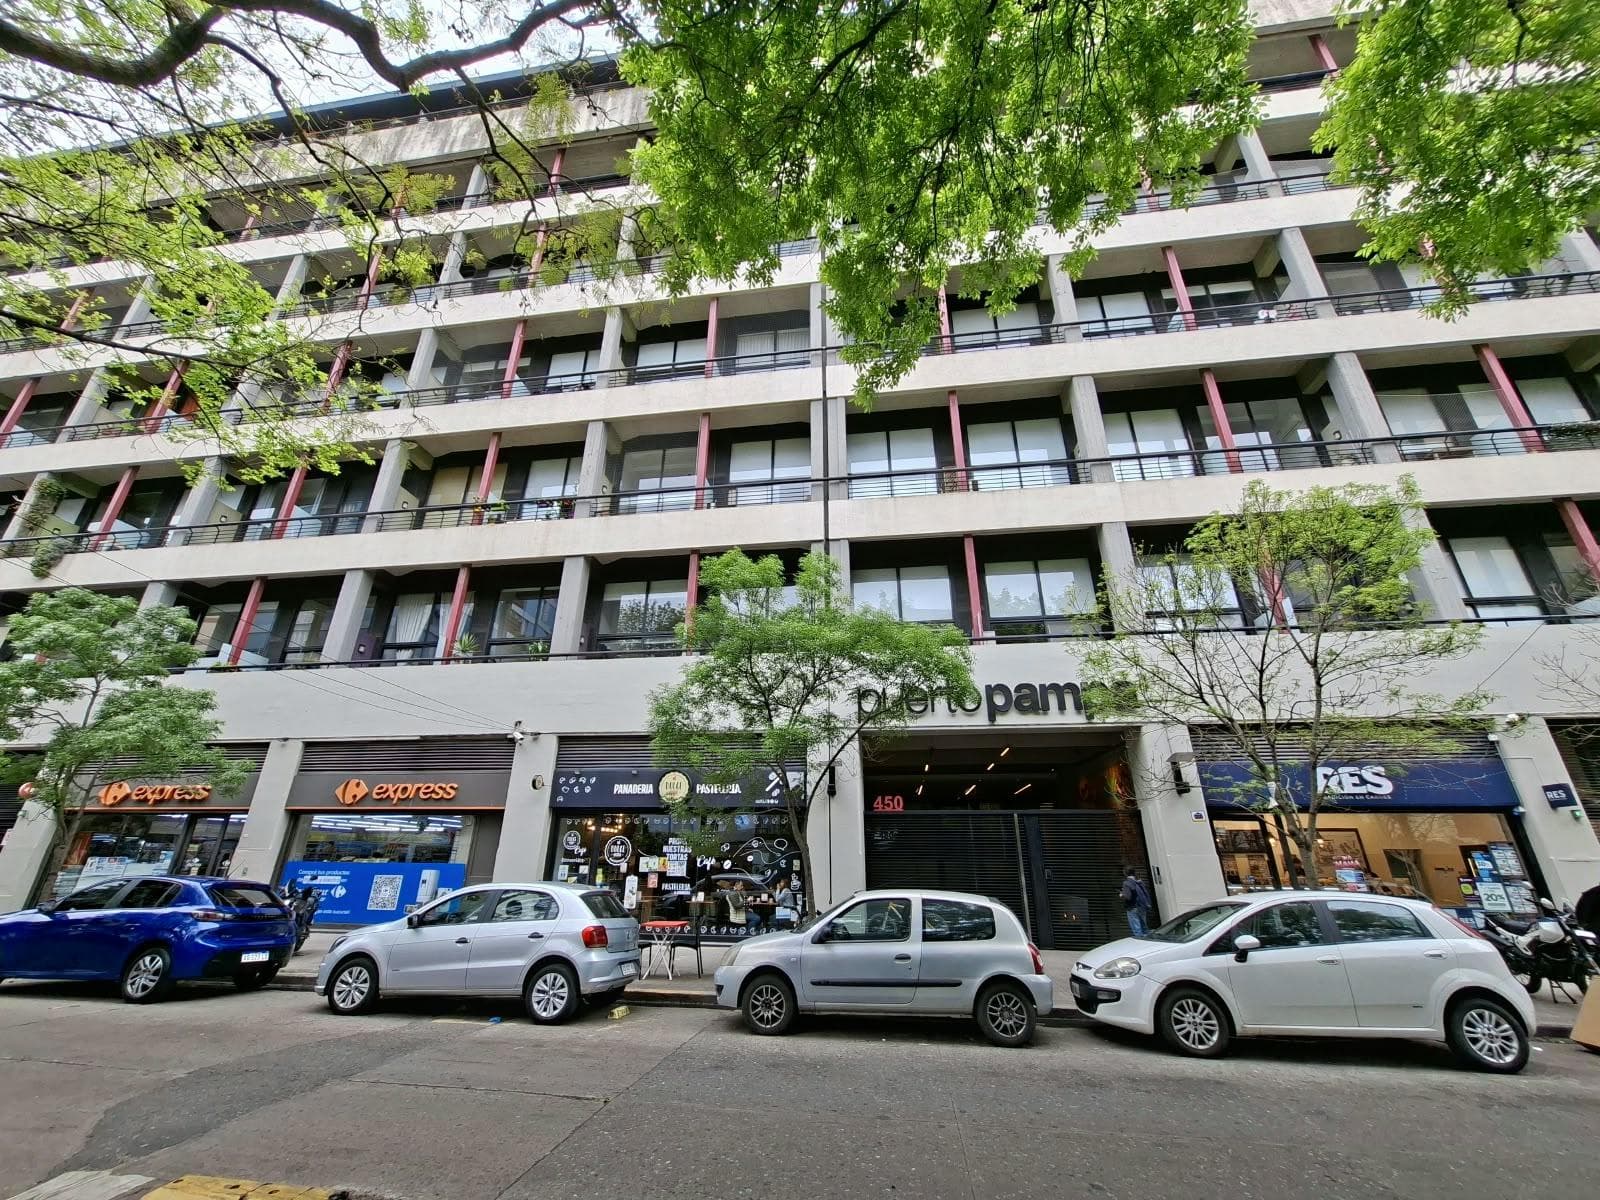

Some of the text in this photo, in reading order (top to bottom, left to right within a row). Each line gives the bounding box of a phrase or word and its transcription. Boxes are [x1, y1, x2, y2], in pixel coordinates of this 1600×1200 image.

[1316, 766, 1393, 795] RES
[131, 784, 213, 805] express
[372, 782, 458, 805] express
[873, 795, 904, 812] 450
[1546, 790, 1567, 799] RES
